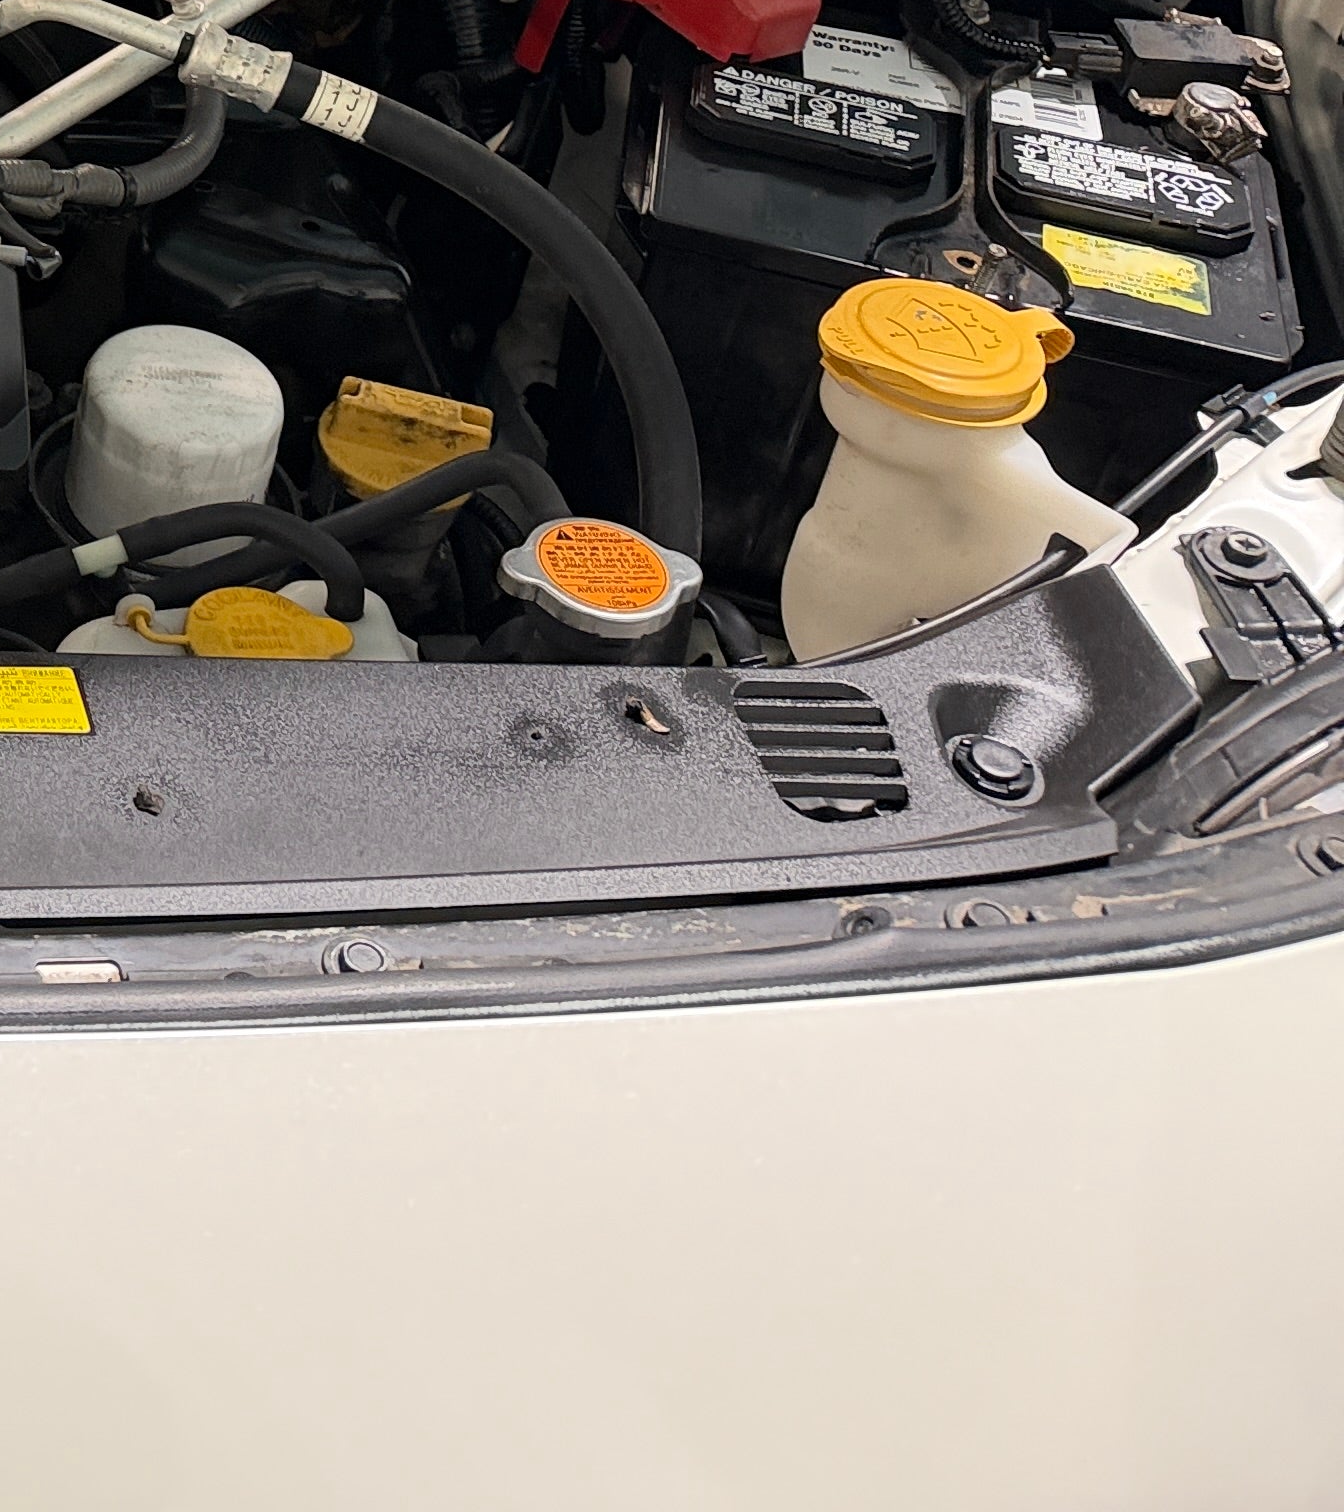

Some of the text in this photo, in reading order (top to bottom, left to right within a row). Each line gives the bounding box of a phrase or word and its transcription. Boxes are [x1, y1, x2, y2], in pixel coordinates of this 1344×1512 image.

[812, 30, 896, 52] Warranty:
[813, 39, 881, 58] 90 Days
[742, 69, 816, 94] DANGER
[835, 90, 904, 113] POISON
[577, 586, 652, 595] AVERTISSEMENT
[194, 589, 306, 622] COOLANT
